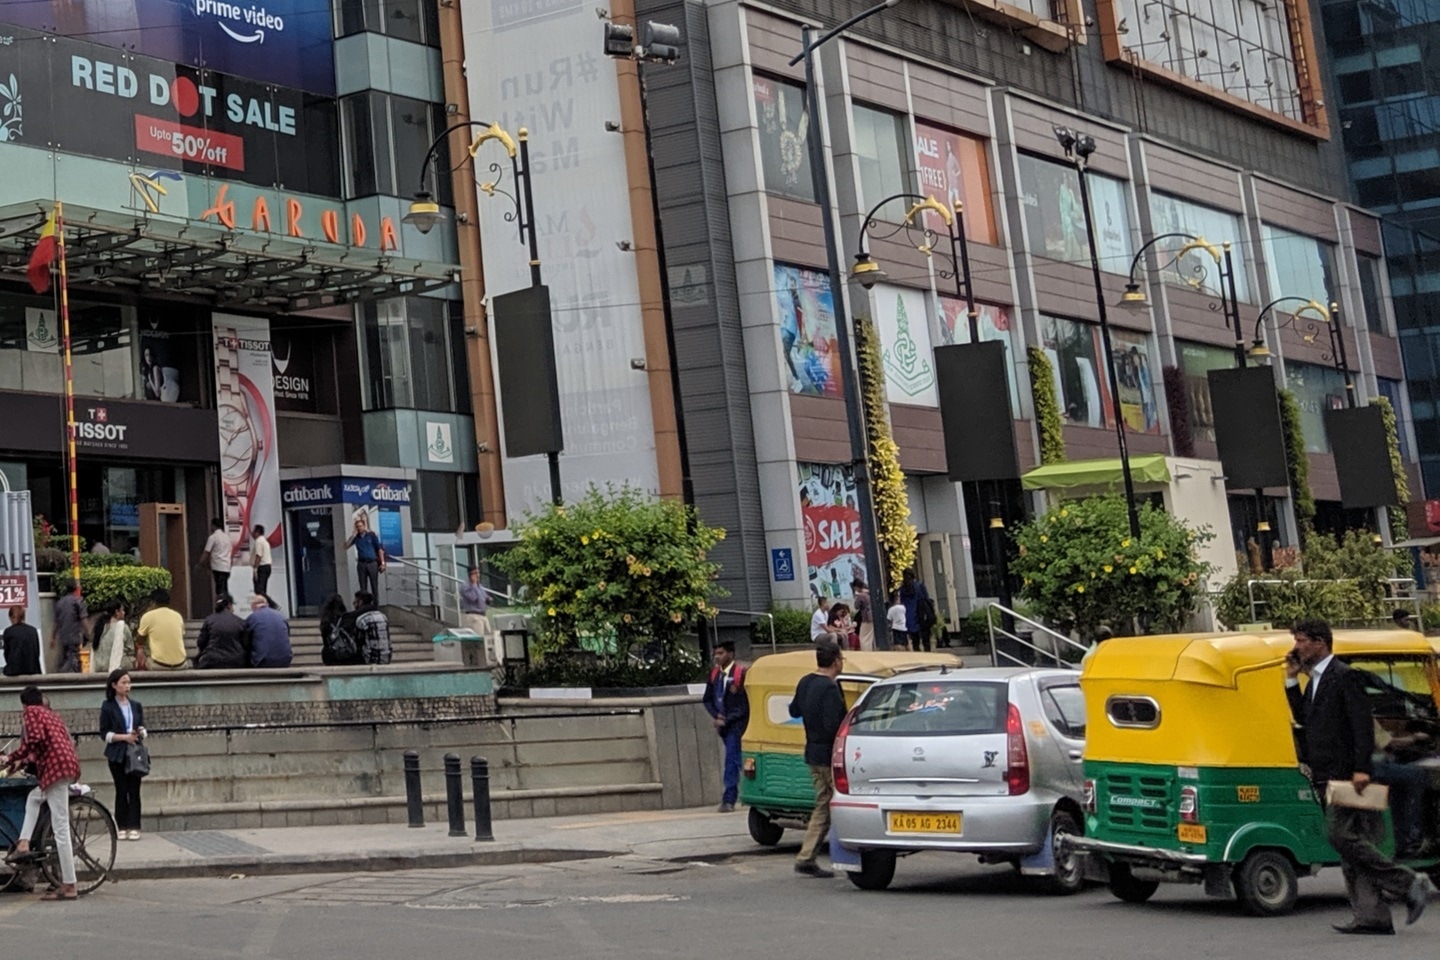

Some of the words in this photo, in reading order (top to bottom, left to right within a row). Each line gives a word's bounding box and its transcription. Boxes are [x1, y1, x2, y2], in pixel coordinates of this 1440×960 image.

[243, 6, 283, 31] video
[71, 55, 138, 98] RED
[149, 73, 216, 117] DOT
[227, 93, 296, 136] SALE
[150, 126, 171, 141] Upto
[171, 132, 211, 160] 50%
[207, 147, 227, 163] off
[917, 136, 939, 158] ALE
[200, 184, 397, 253] GARUDA
[239, 341, 269, 350] TISSOT
[67, 421, 126, 440] TISSOT
[284, 484, 333, 502] citibank
[372, 484, 411, 501] citibank
[818, 519, 862, 550] SALE
[893, 817, 904, 828] KA
[906, 817, 917, 828] 05
[921, 818, 931, 829] AG
[936, 818, 957, 830] 2344
